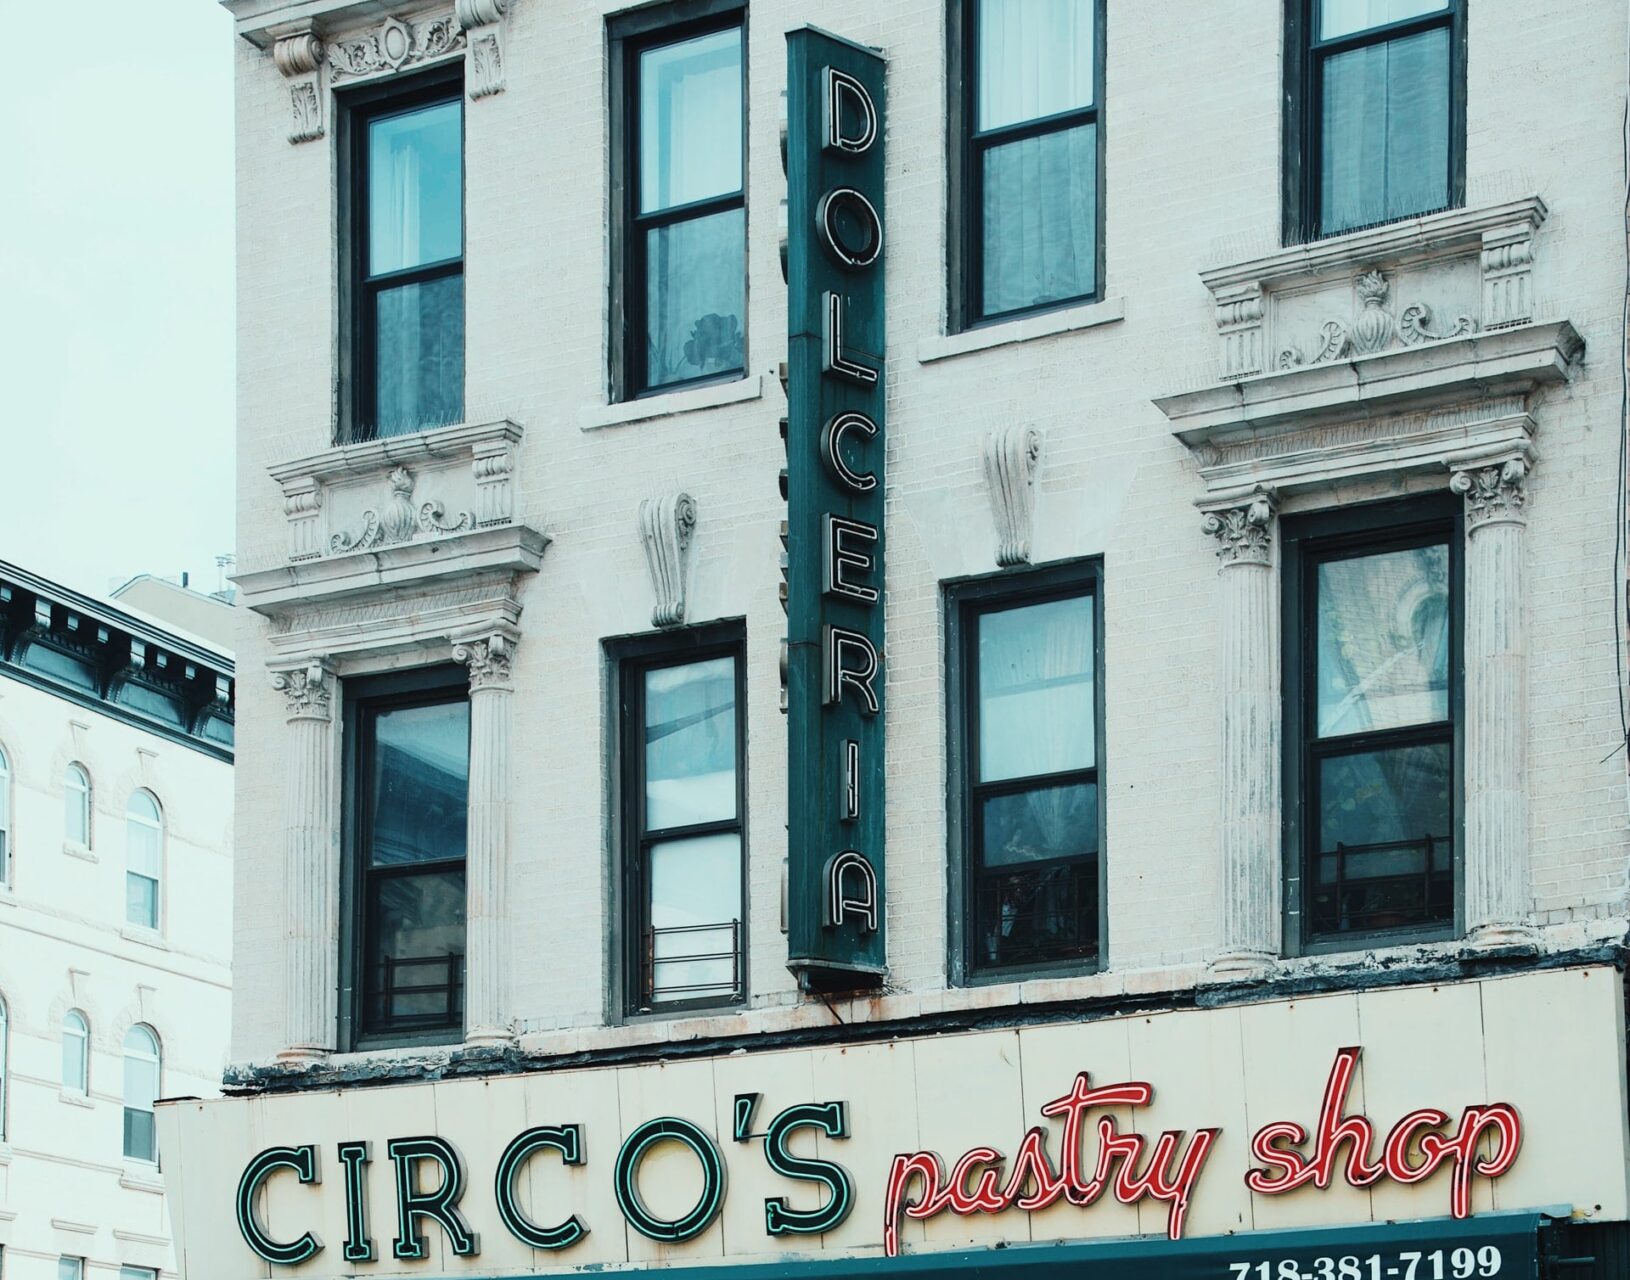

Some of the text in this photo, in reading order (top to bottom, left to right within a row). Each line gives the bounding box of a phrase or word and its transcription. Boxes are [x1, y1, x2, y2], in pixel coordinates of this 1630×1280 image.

[815, 64, 884, 934] DOLCERIA
[236, 1045, 1526, 1266] CIRCO'S pastry shop
